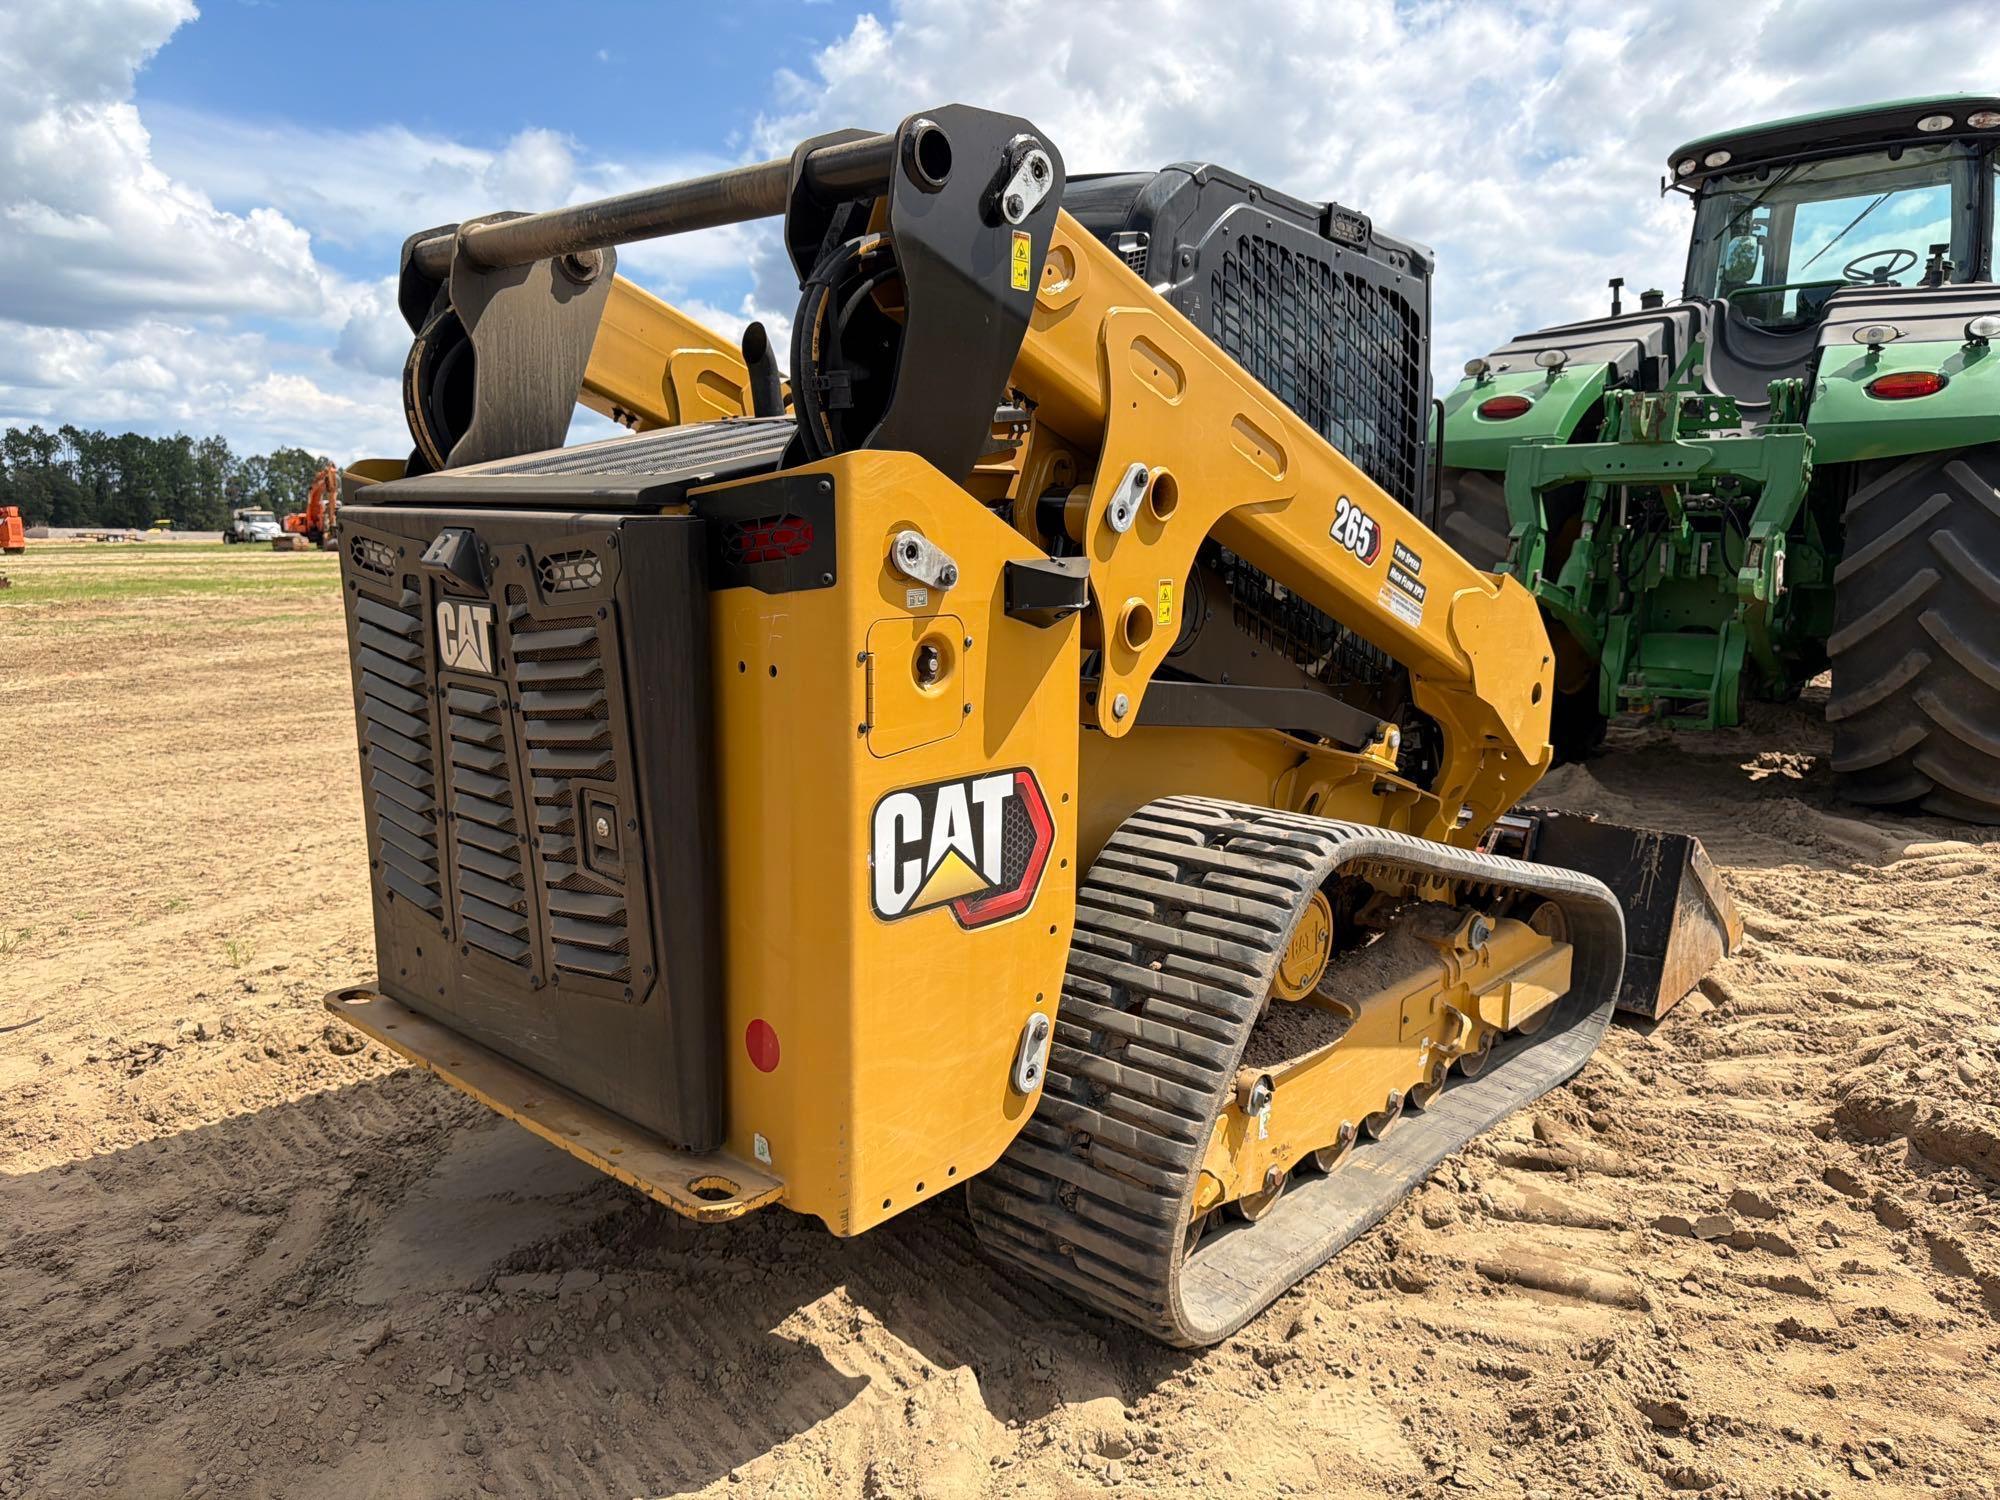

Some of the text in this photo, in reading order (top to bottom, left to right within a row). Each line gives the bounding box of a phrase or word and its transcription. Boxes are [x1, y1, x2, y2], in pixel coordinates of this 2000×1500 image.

[1330, 497, 1374, 558] 265
[1413, 584, 1425, 600] XPS
[436, 601, 492, 673] CAT
[875, 773, 1014, 916] CAT
